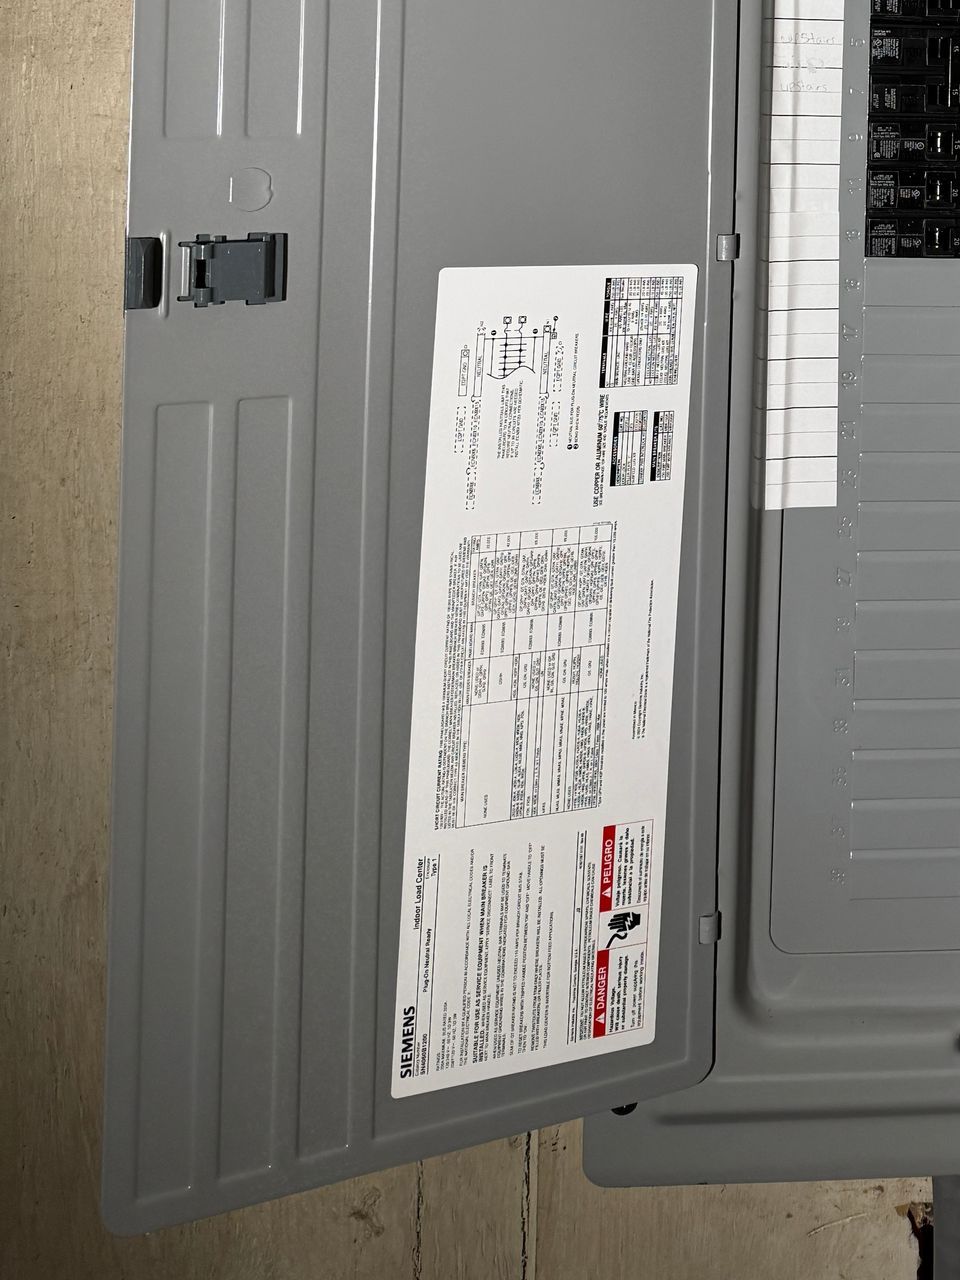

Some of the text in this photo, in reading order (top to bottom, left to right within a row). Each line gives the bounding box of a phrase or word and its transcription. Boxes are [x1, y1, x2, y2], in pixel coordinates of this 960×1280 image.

[952, 88, 959, 96] 15
[848, 132, 863, 143] 9
[951, 188, 959, 198] 20
[952, 237, 960, 247] 20
[842, 323, 859, 342] 17
[541, 351, 549, 374] NEUTRAL
[841, 370, 857, 389] 19
[595, 462, 600, 470] OR
[430, 862, 438, 877] Type
[602, 838, 613, 883] PELIGRO
[412, 857, 424, 930] Indoor Load Center
[422, 927, 433, 993] Plug-On Neutral Ready
[476, 936, 484, 971] EQUIPMENT
[596, 965, 607, 1009] DANGER
[475, 998, 480, 1007] AS
[399, 1005, 416, 1079] SIEMENS
